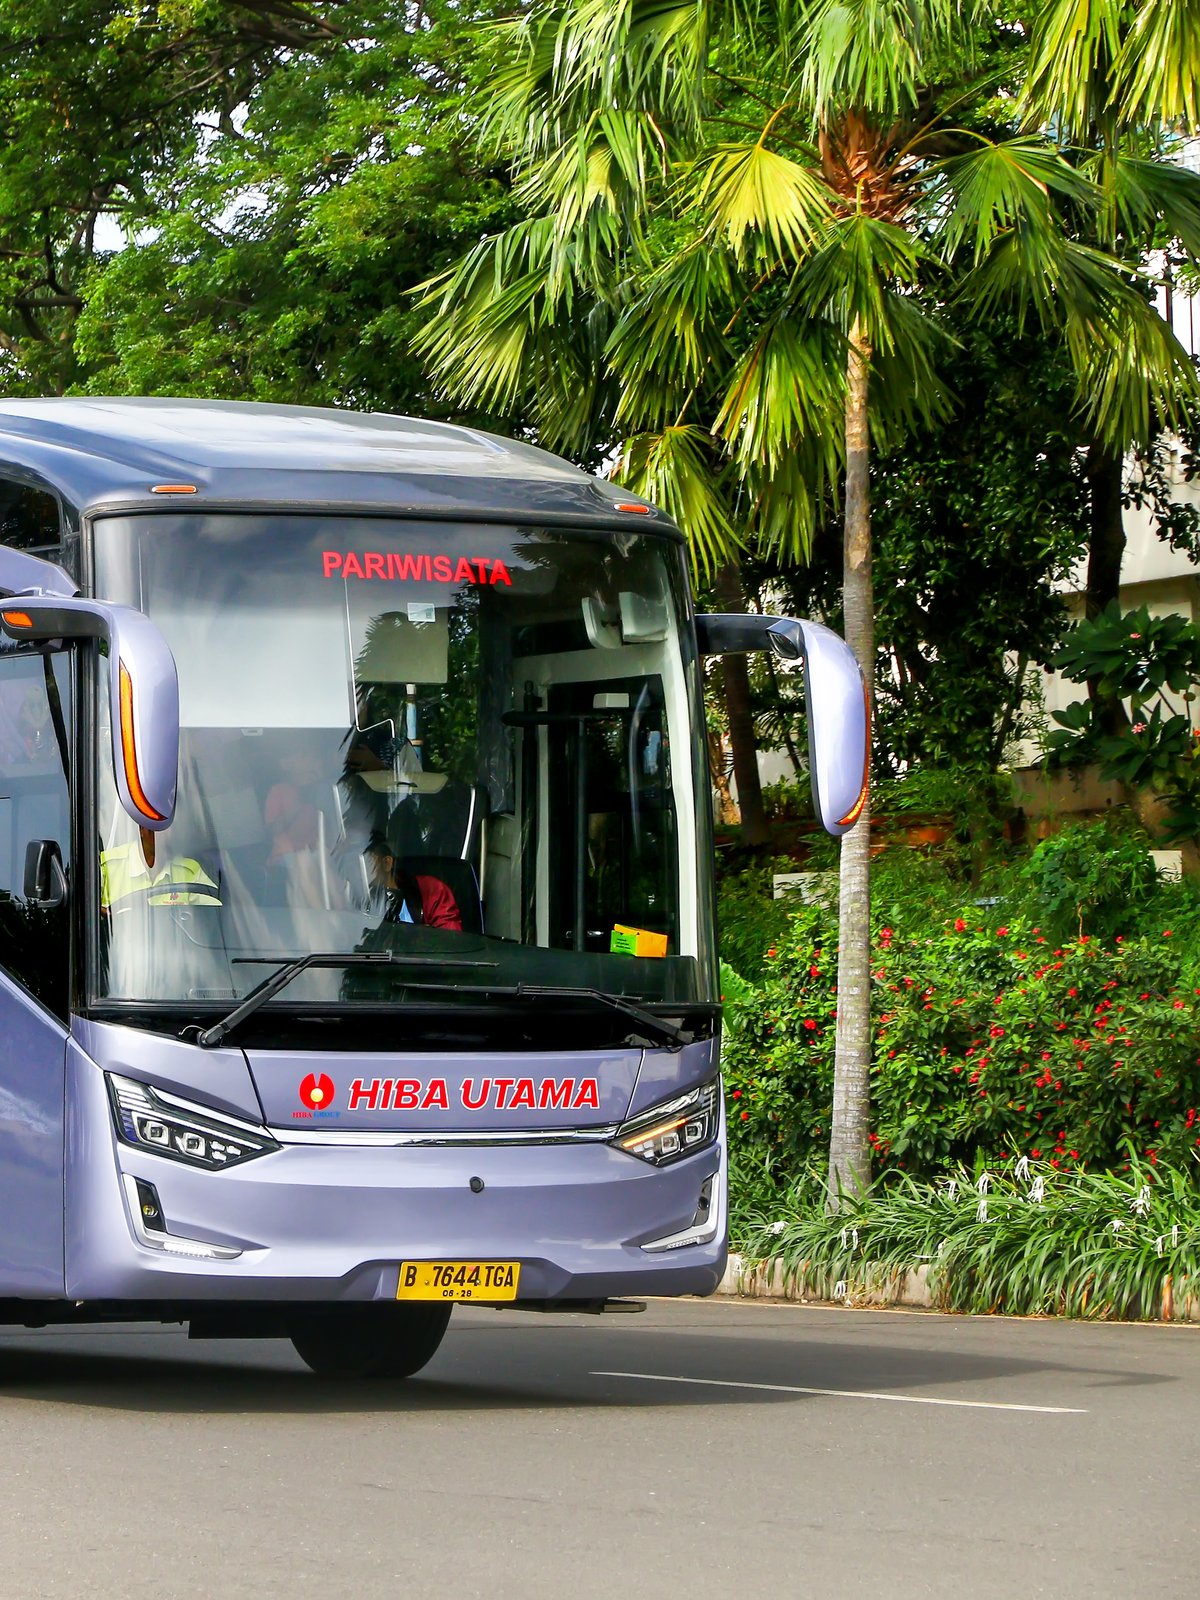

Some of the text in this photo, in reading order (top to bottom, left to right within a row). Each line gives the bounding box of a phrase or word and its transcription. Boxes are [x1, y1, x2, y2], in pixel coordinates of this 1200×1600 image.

[322, 551, 513, 586] PARIWISATA
[347, 1077, 600, 1111] HIBA UTAMA
[292, 1111, 313, 1119] HIBA
[404, 1265, 514, 1287] B 7644 TGA
